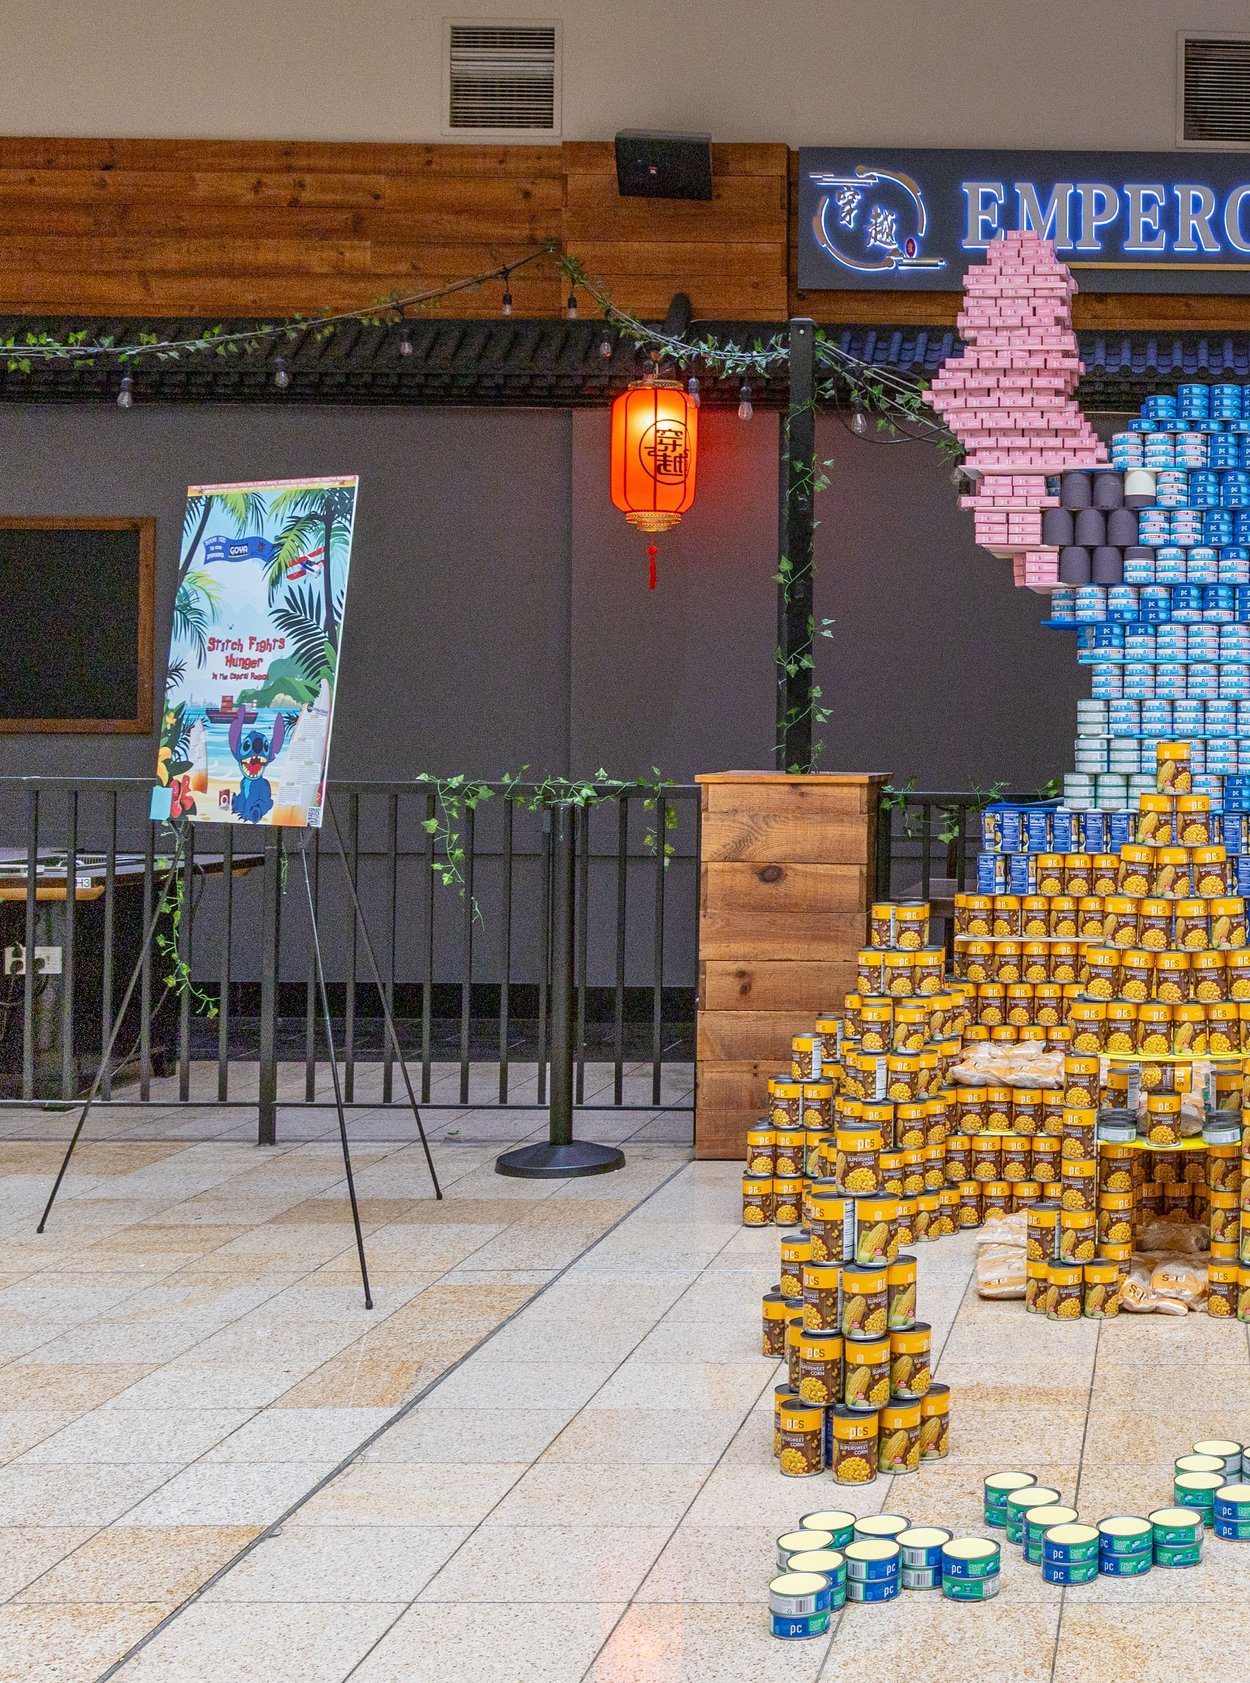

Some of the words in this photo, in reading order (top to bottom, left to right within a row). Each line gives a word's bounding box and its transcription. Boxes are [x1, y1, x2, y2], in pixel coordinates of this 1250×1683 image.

[230, 545, 248, 555] GOYA
[207, 637, 243, 653] Stitch
[248, 636, 285, 653] Fights
[225, 654, 263, 670] Hunger
